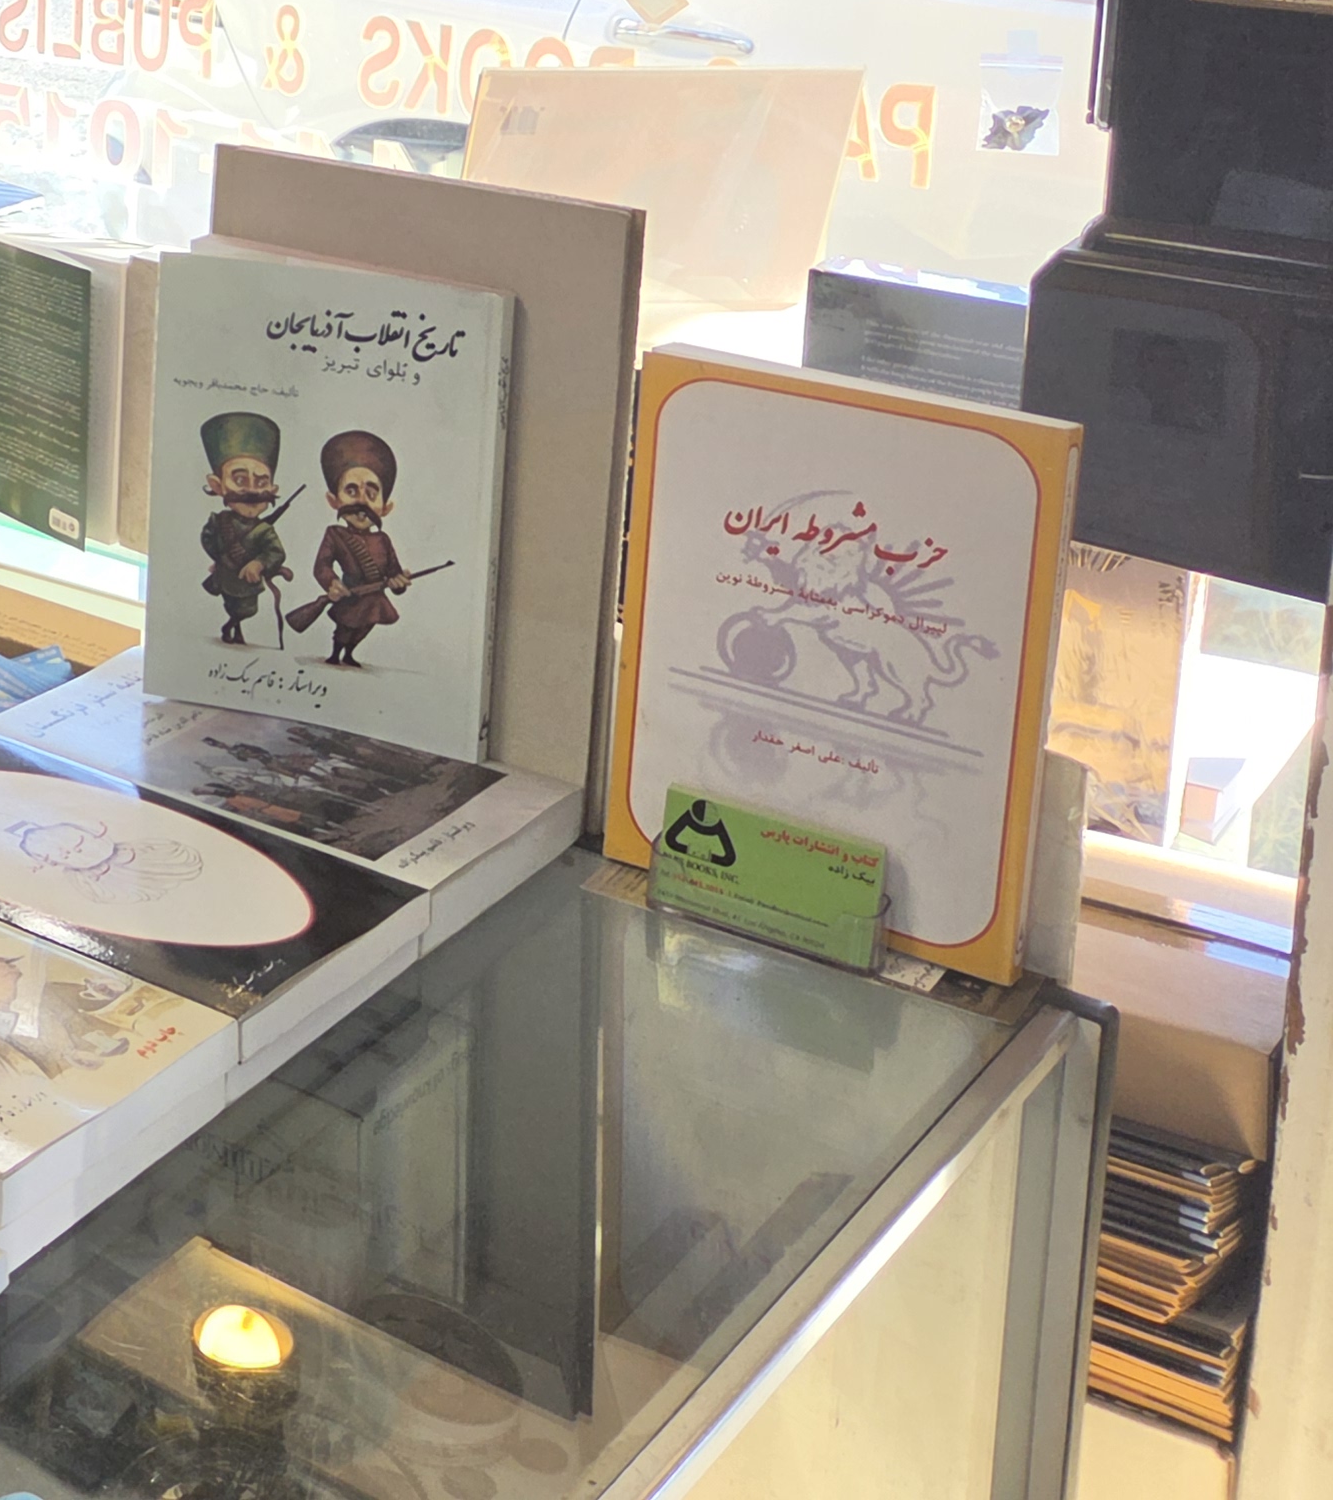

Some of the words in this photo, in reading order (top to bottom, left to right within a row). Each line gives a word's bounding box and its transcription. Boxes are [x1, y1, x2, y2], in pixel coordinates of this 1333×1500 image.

[265, 308, 355, 354] آذربایجان
[343, 309, 411, 354] انقلاب
[411, 312, 466, 362] تاریخ
[321, 355, 361, 375] تبریز
[411, 371, 421, 386] و
[723, 505, 791, 556] ایران
[790, 500, 878, 556] مشروطه
[873, 536, 949, 577] حزب
[715, 572, 744, 587] نوین
[841, 602, 905, 624] دموکراسی
[908, 616, 948, 635] لیبرال
[253, 670, 277, 702] قاسم
[287, 669, 329, 710] ویراستار
[760, 828, 791, 846] پارس
[792, 833, 840, 857] انتشارات
[827, 865, 850, 880] زاده
[851, 853, 880, 868] کتاب
